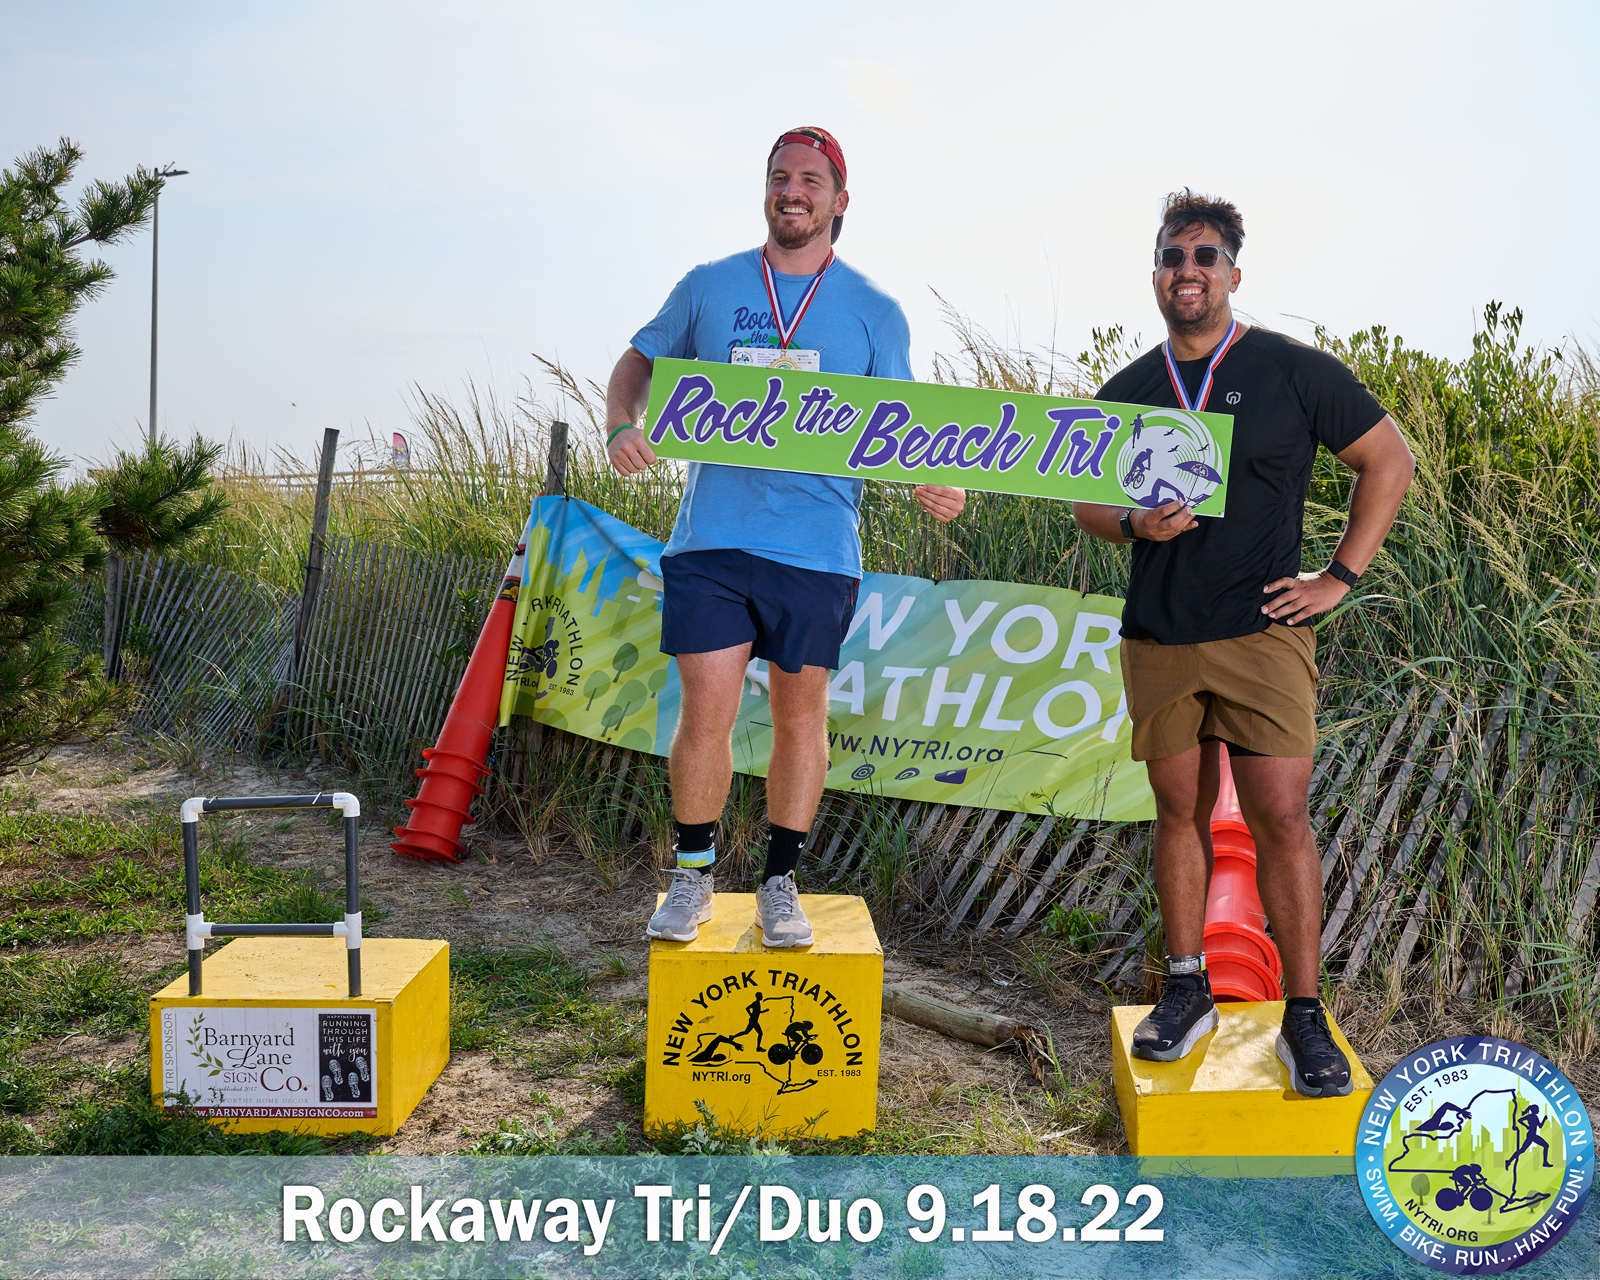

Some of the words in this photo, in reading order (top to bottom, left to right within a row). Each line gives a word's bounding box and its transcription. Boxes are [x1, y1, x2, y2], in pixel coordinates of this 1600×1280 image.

[750, 330, 770, 344] the
[650, 374, 788, 448] Rock
[795, 387, 862, 434] the
[847, 400, 1035, 471] Beach
[1036, 407, 1121, 477] Tri
[505, 634, 524, 682] NEW
[551, 596, 584, 687] RIATHLON
[944, 599, 1122, 673] YOR
[548, 683, 559, 692] EST.
[560, 686, 575, 697] 1983
[746, 657, 1134, 743] ATHLO
[662, 1012, 694, 1066] NEW
[690, 970, 759, 1010] YORK
[768, 969, 863, 1066] TRIATHLON
[163, 1012, 174, 1066] SPONSOR
[203, 1027, 295, 1050] Barnyard
[227, 1046, 292, 1070] Lane
[322, 1042, 346, 1058] with
[347, 1046, 369, 1063] you
[164, 1069, 175, 1101] YTRI
[223, 1071, 258, 1083] SIGN
[260, 1066, 309, 1092] Co.
[692, 1071, 751, 1084] NYTRI.org
[840, 1069, 862, 1077] 1983
[179, 1108, 364, 1118] ww.BARNYARDLANESIGNCO.com
